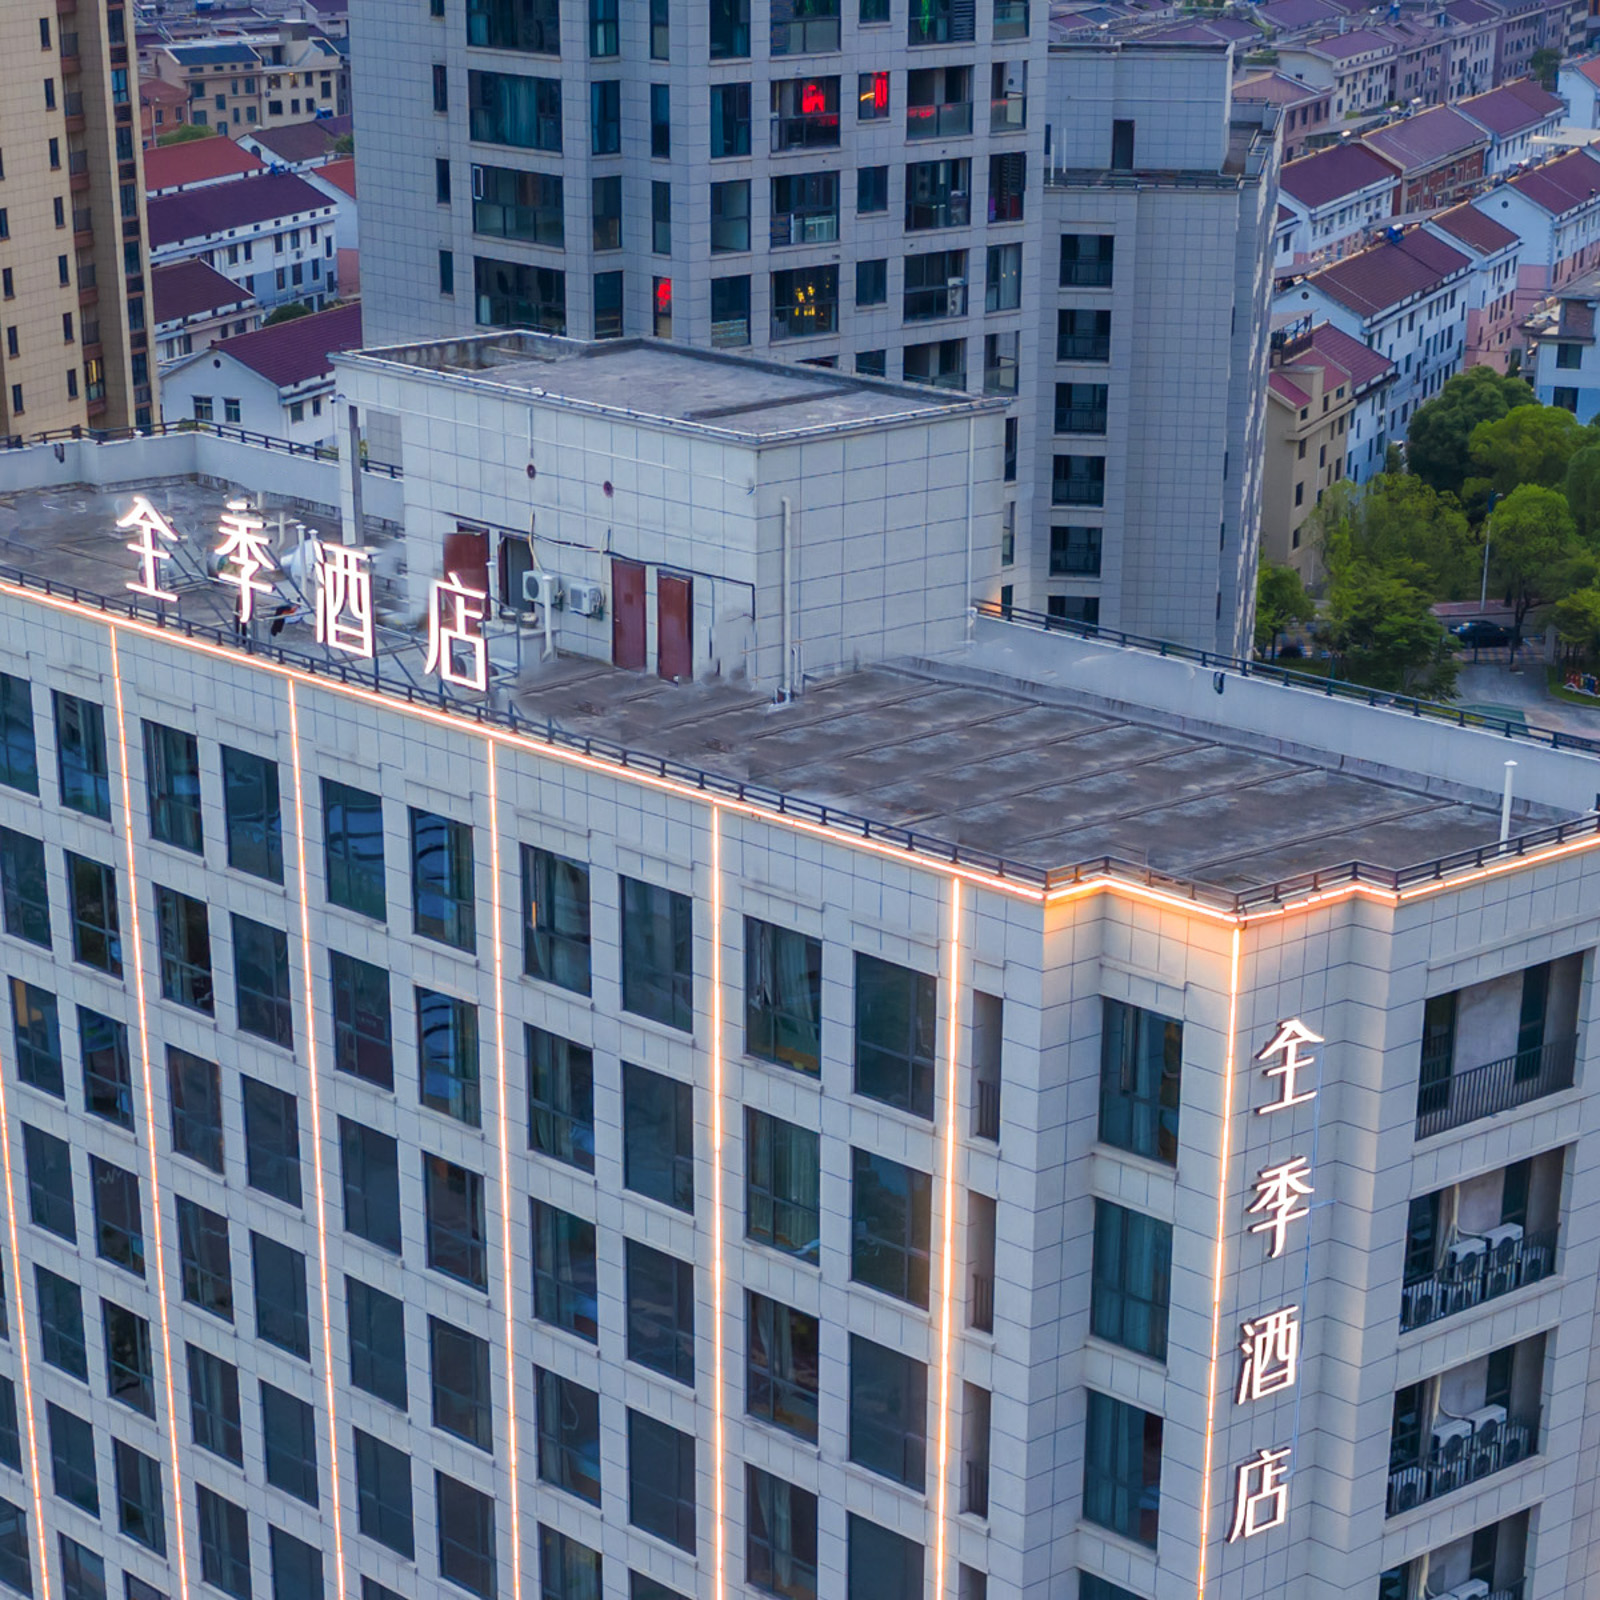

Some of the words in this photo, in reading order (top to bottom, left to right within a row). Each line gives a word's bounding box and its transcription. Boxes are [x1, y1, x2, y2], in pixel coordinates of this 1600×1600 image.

[116, 496, 488, 692] 全季酒店
[1230, 1018, 1325, 1544] 全季酒店
